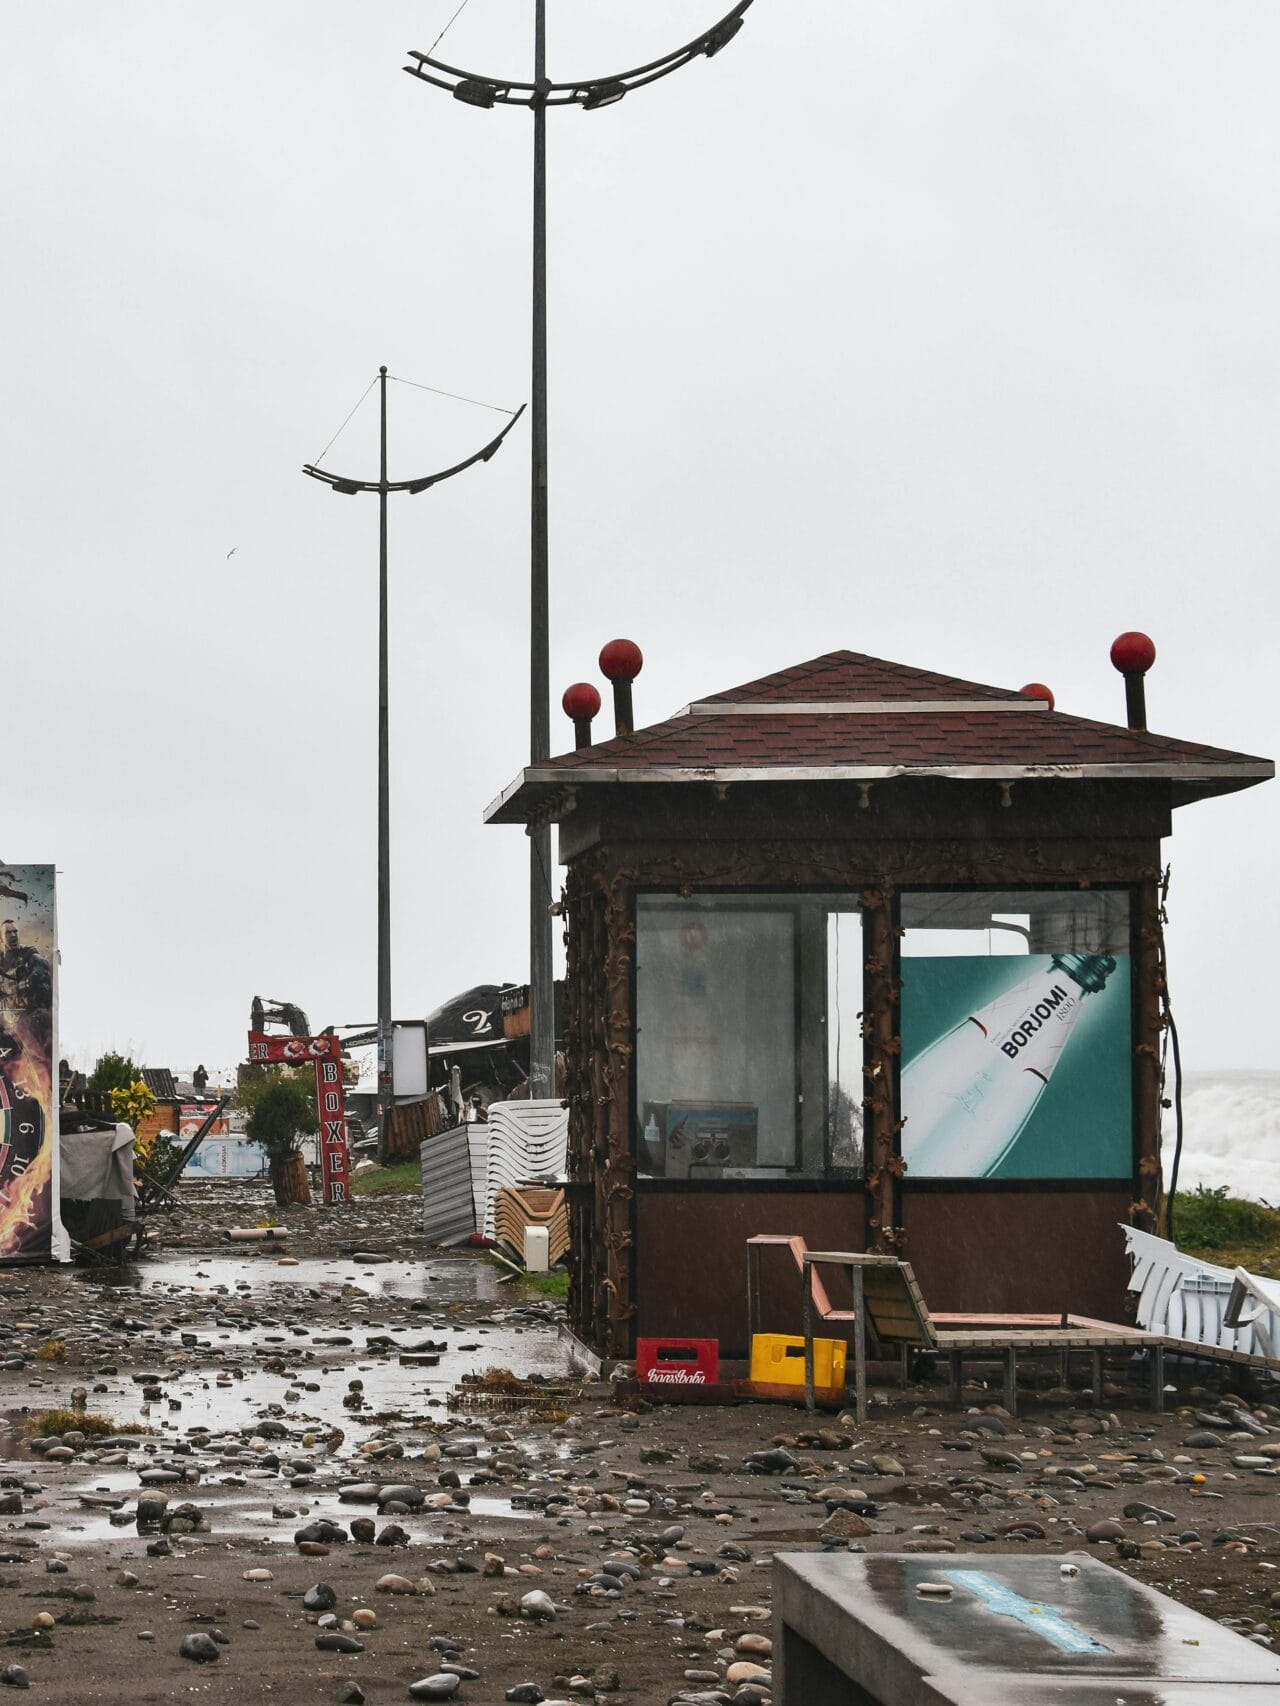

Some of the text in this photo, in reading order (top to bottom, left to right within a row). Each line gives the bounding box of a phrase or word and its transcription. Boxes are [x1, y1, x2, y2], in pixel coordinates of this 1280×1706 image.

[1000, 985, 1068, 1059] BORJOMI
[0, 1047, 12, 1058] 4
[12, 1079, 31, 1100] 13
[19, 1122, 35, 1134] 6
[322, 1062, 345, 1202] BOXER
[10, 1154, 30, 1177] 10
